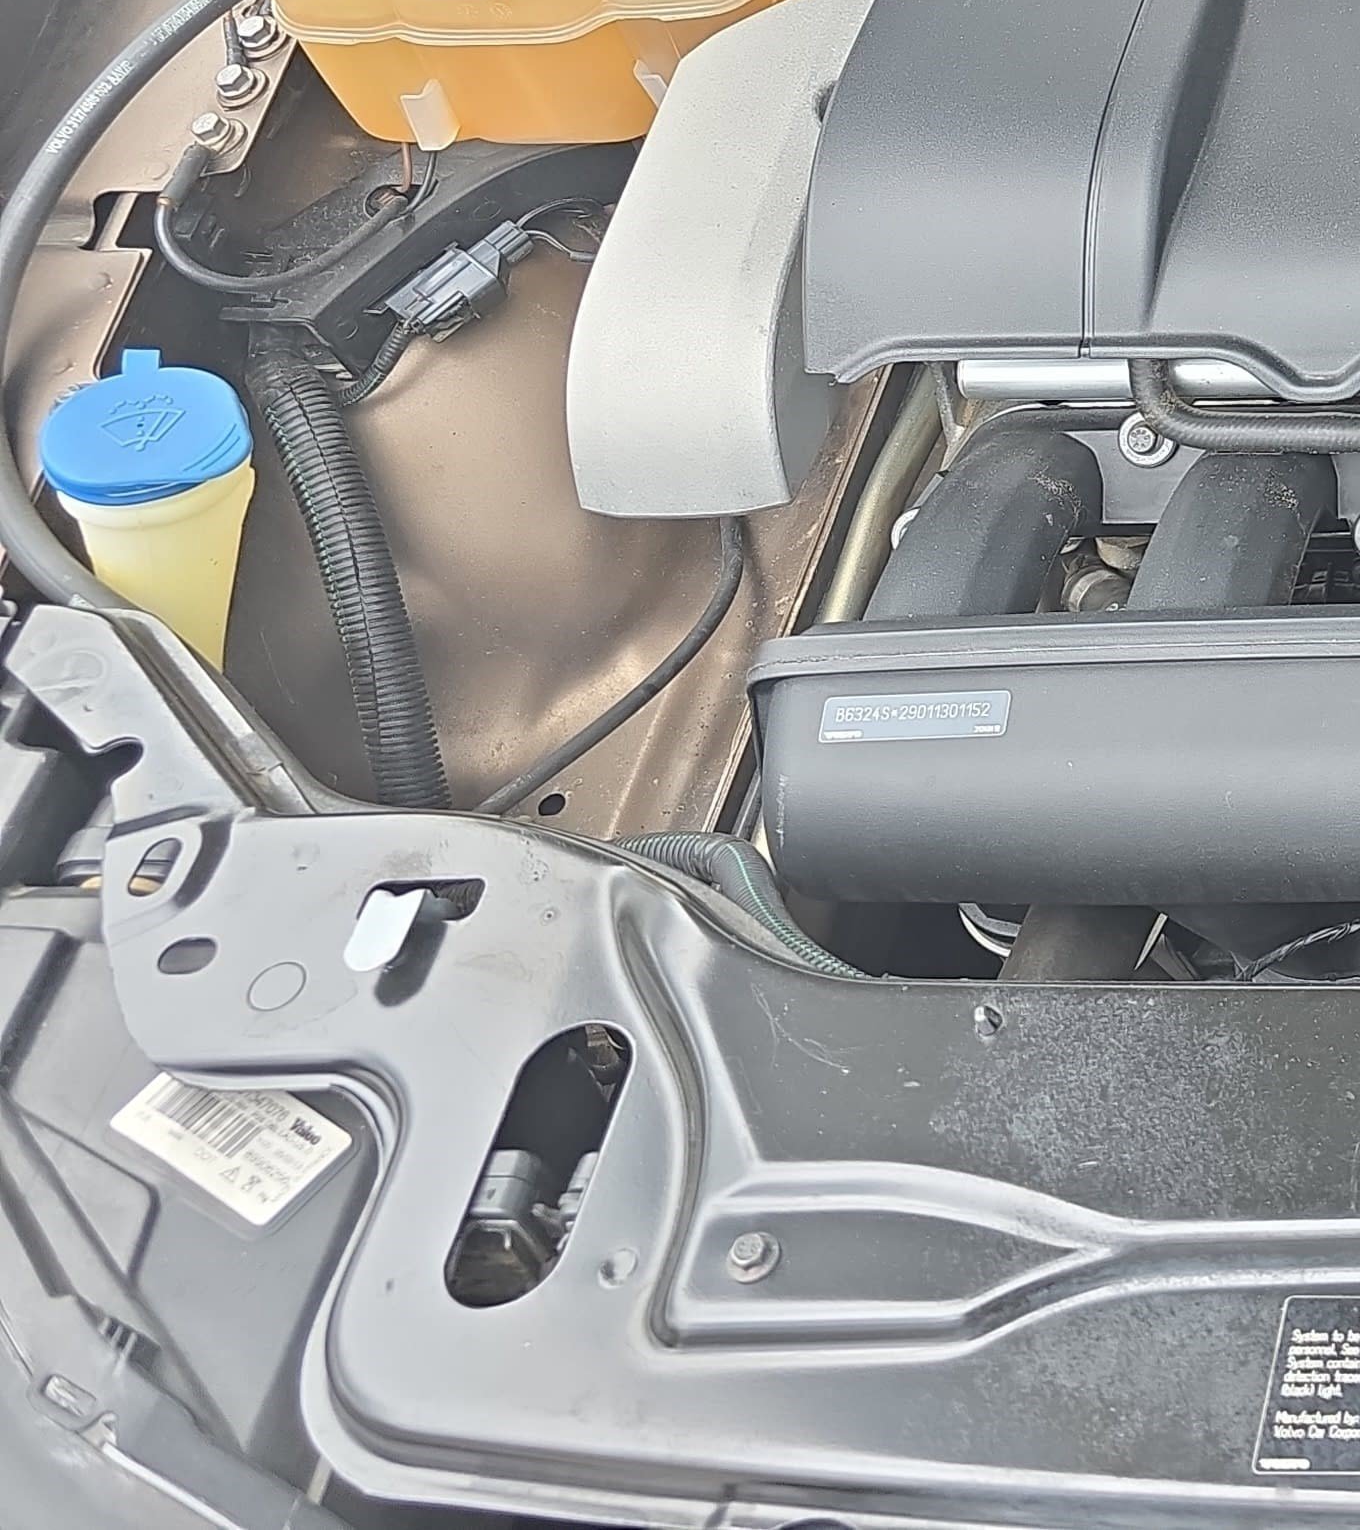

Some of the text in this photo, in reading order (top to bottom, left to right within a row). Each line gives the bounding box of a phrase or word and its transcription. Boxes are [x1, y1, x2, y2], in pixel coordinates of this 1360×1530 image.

[48, 126, 73, 156] VOLVO
[289, 1117, 321, 1146] Valeo
[1292, 1329, 1329, 1343] System
[1332, 1330, 1344, 1342] to
[1347, 1330, 1360, 1342] be
[1340, 1343, 1360, 1356] See
[1287, 1358, 1324, 1370] System
[1275, 1410, 1342, 1424] Manufactured
[1273, 1425, 1306, 1439] Volvo
[1308, 1425, 1325, 1439] Car
